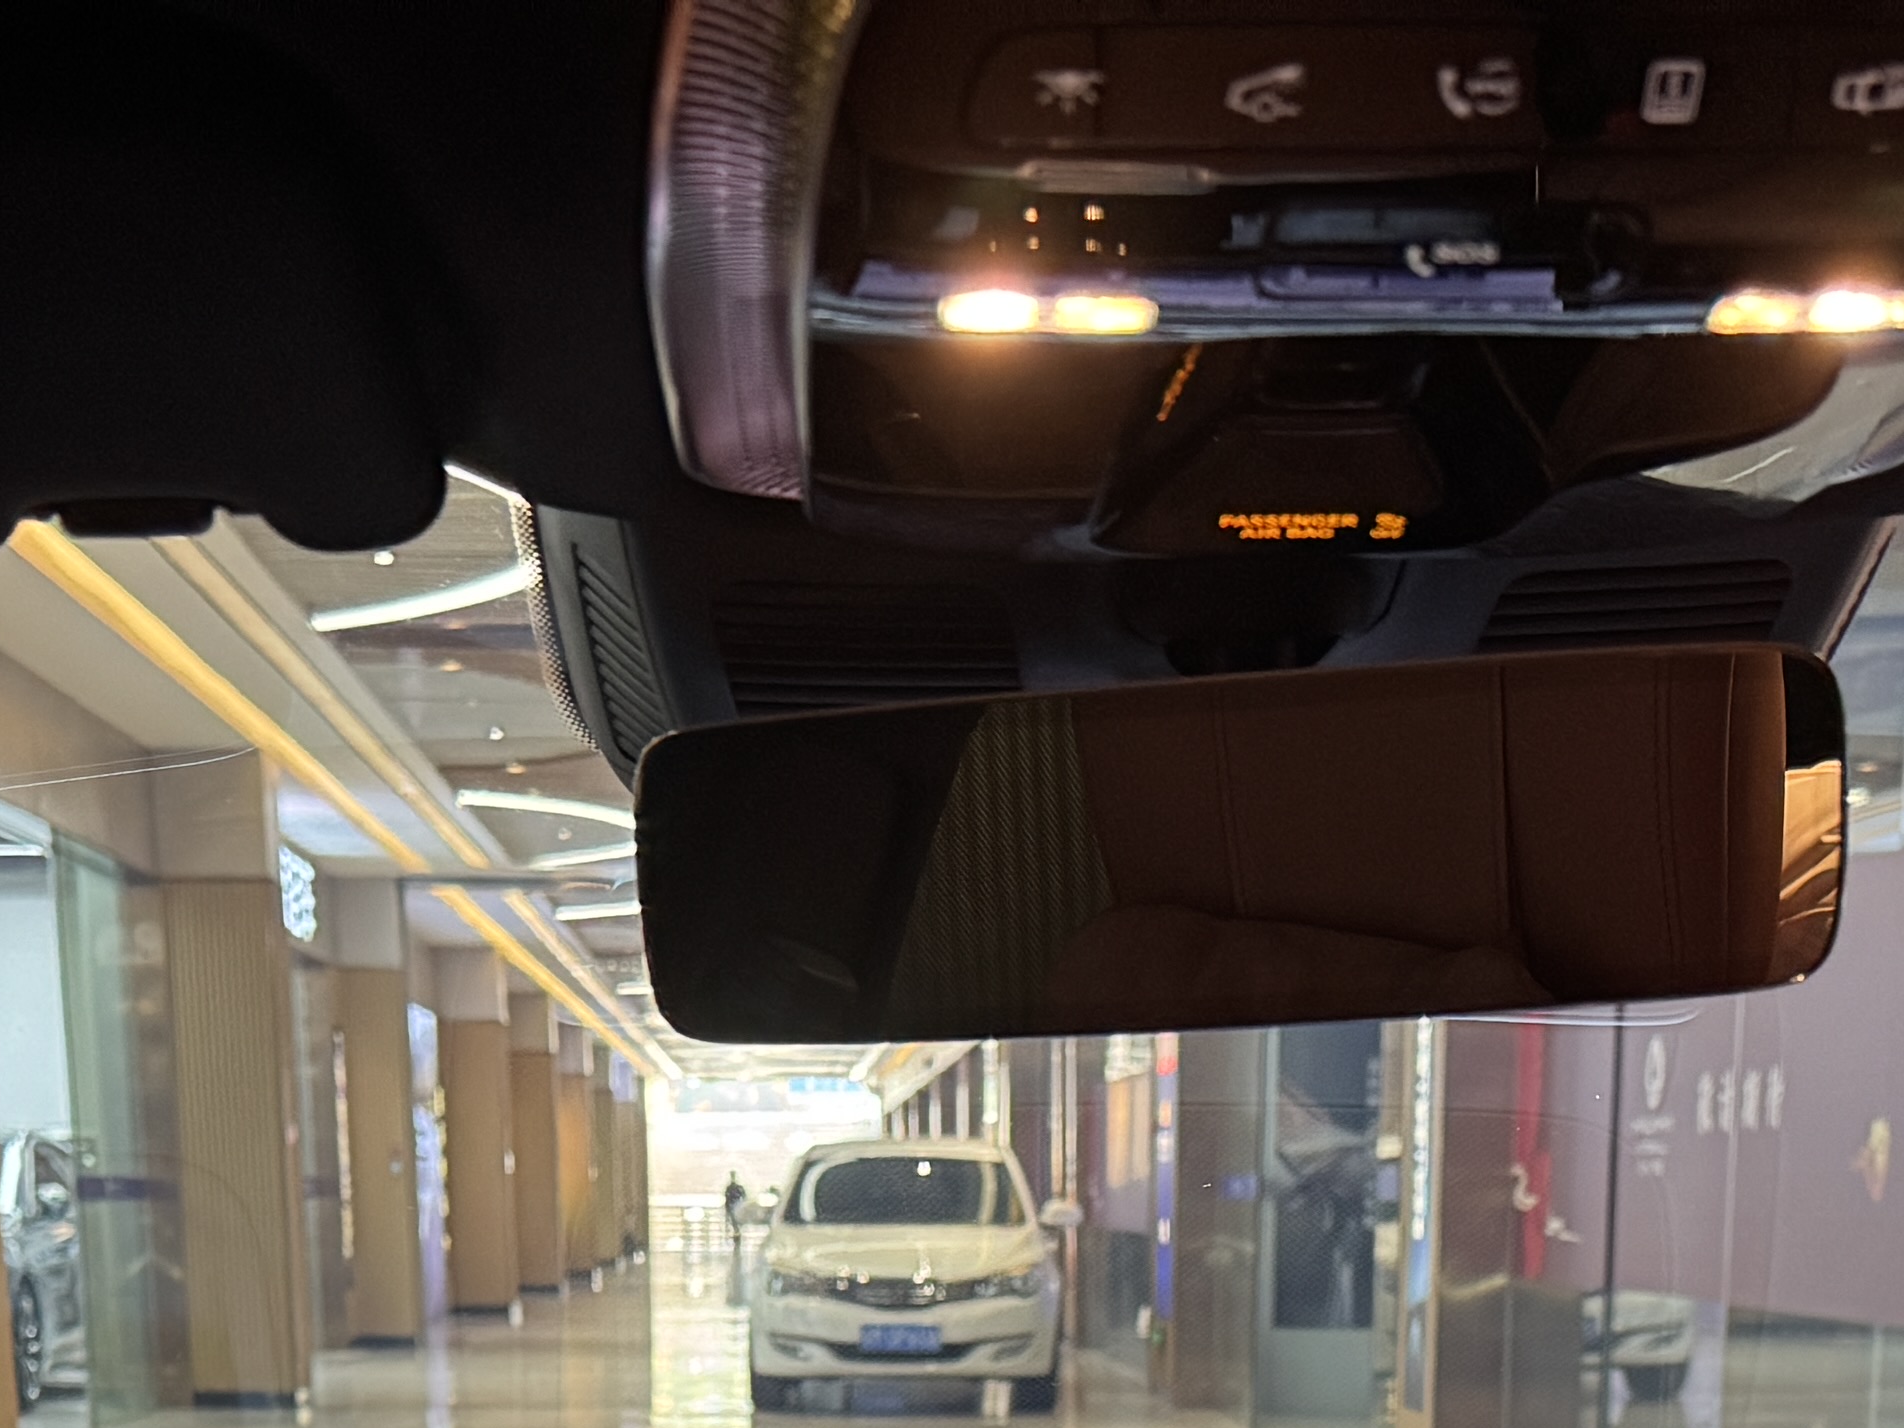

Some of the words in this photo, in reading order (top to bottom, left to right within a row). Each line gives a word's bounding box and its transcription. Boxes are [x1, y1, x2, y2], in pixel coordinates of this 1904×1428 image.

[1219, 513, 1359, 528] PASSENGER
[1239, 528, 1282, 539] AIR
[1286, 528, 1335, 539] BAG
